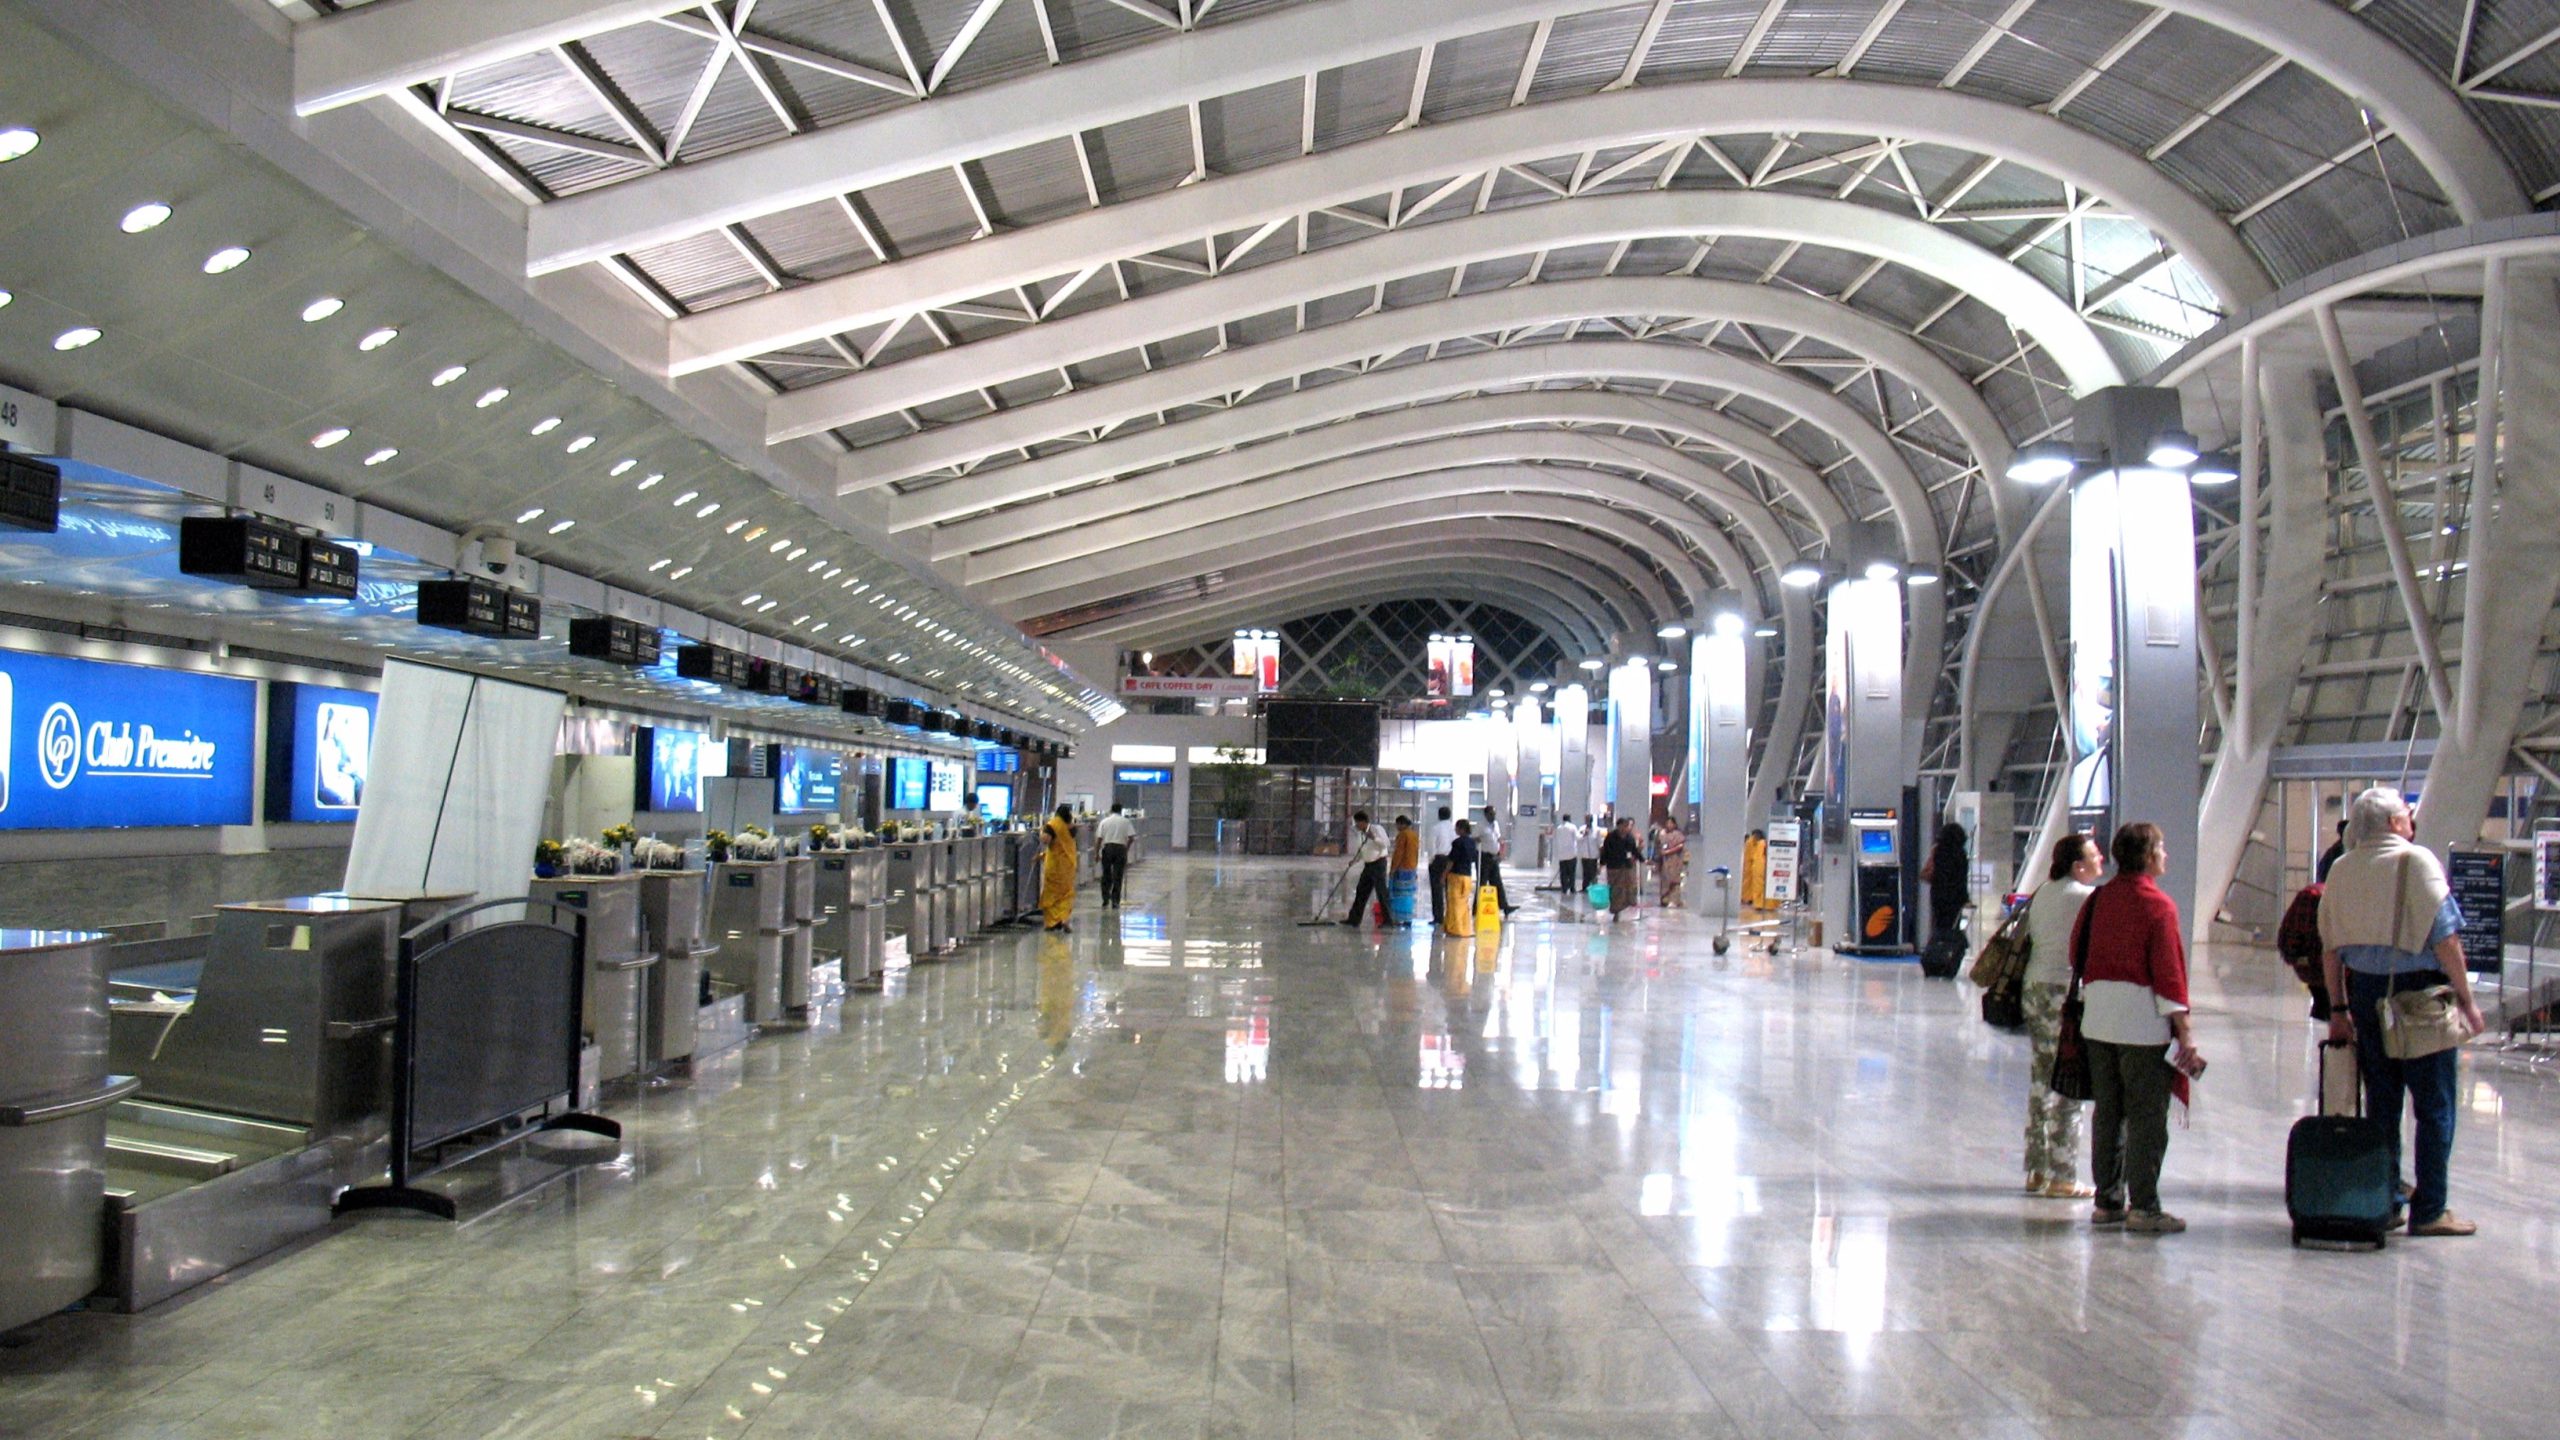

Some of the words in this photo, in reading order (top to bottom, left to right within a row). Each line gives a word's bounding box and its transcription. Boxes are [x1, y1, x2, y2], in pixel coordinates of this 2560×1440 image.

[1, 402, 18, 428] 48
[263, 483, 276, 504] 49
[324, 501, 336, 522] 50
[1163, 681, 1193, 691] COFFEE
[1196, 682, 1214, 691] DAY
[86, 720, 134, 768] Club
